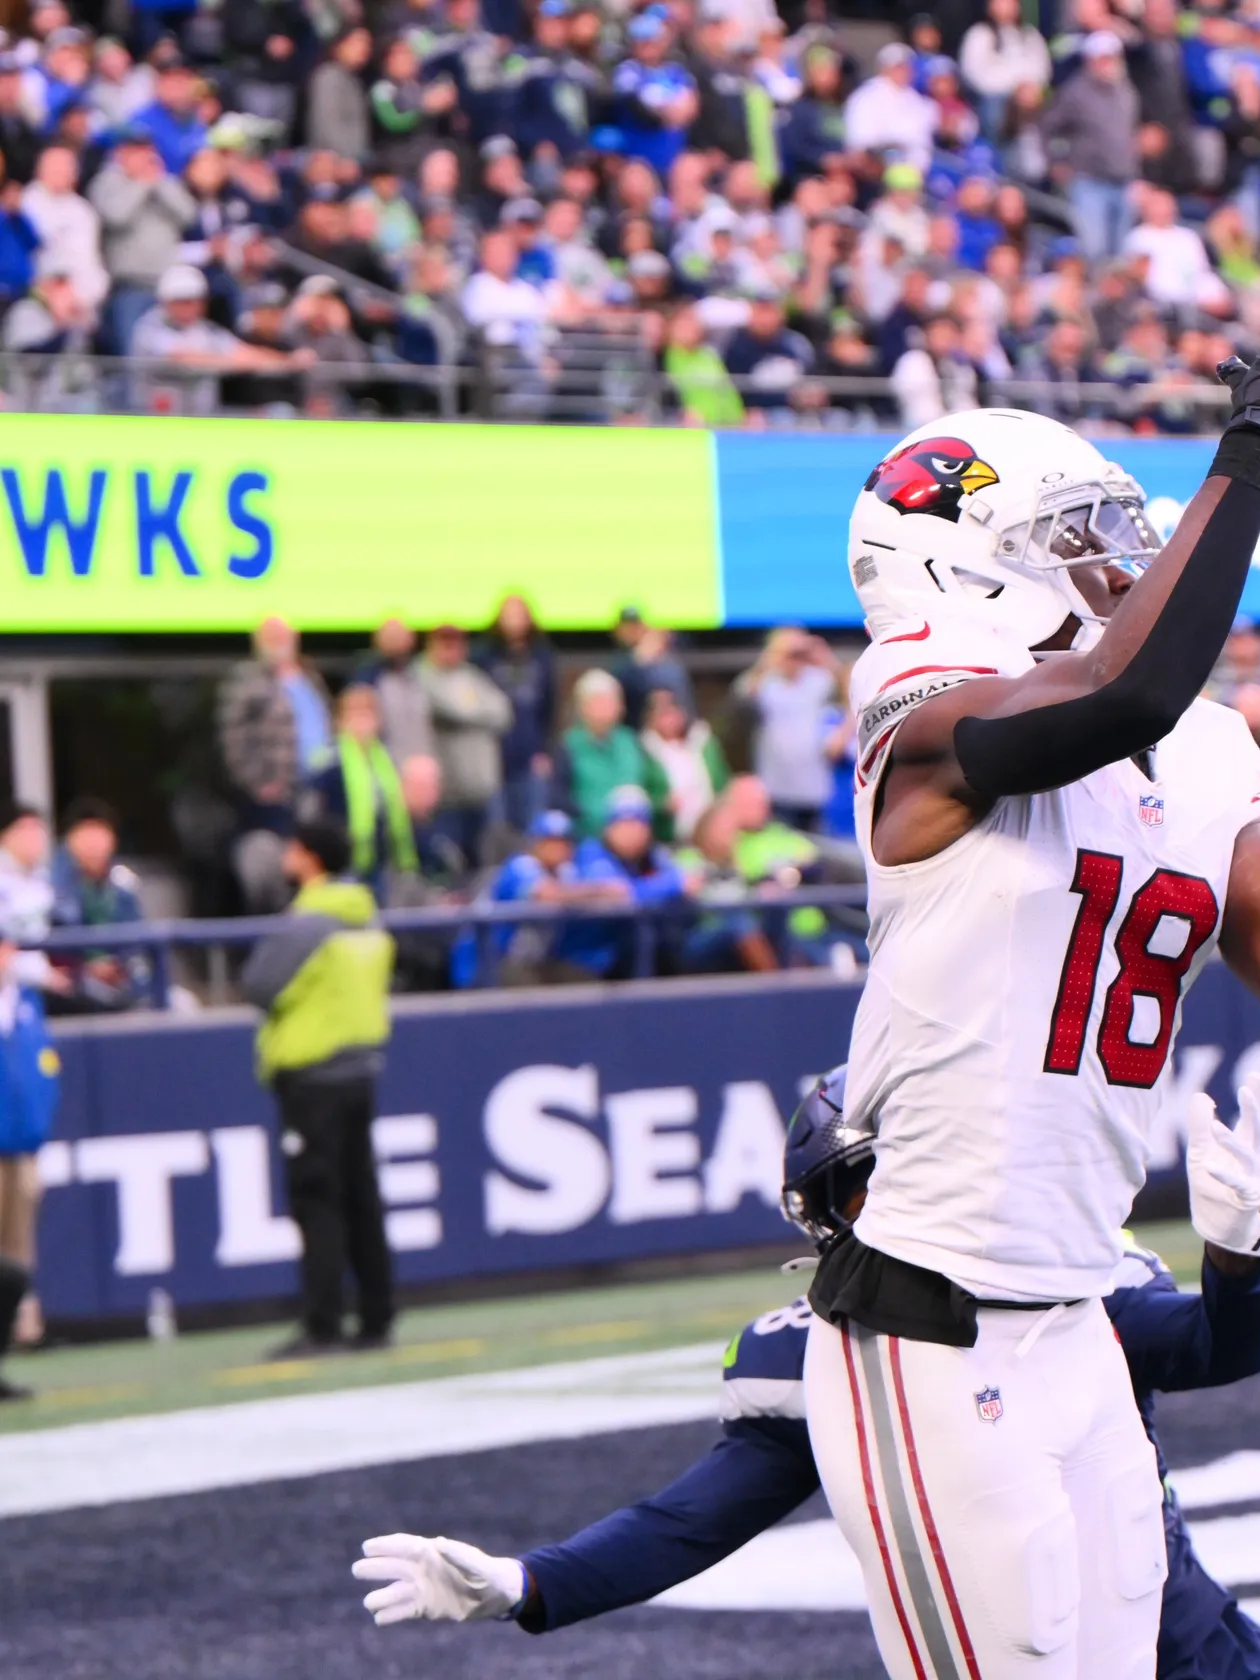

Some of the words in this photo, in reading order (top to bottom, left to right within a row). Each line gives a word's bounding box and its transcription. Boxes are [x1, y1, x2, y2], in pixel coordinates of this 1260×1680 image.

[1, 468, 273, 579] WKS
[1141, 806, 1162, 823] NFL
[1043, 847, 1220, 1090] 18
[38, 1113, 443, 1276] TLE
[981, 1401, 1002, 1418] NFL
